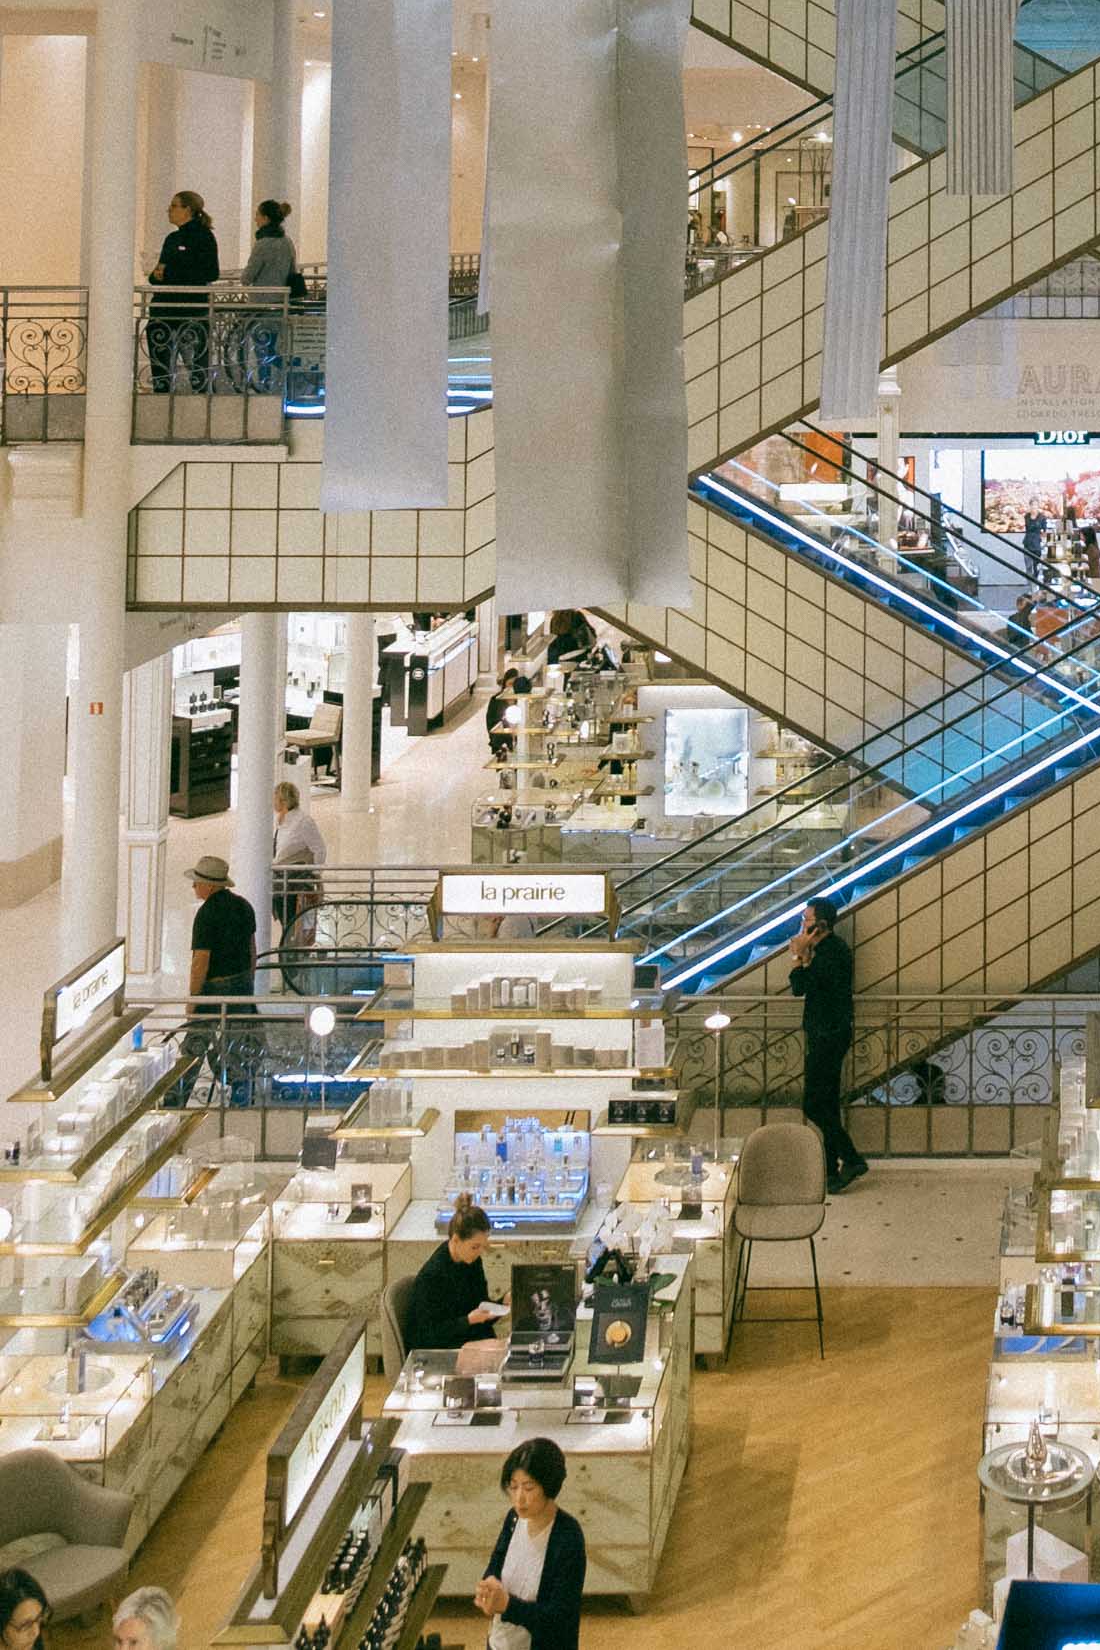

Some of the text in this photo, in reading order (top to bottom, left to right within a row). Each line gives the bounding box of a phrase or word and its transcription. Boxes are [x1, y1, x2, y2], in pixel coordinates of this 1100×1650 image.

[1037, 430, 1088, 444] Dior
[480, 880, 566, 907] la prairie
